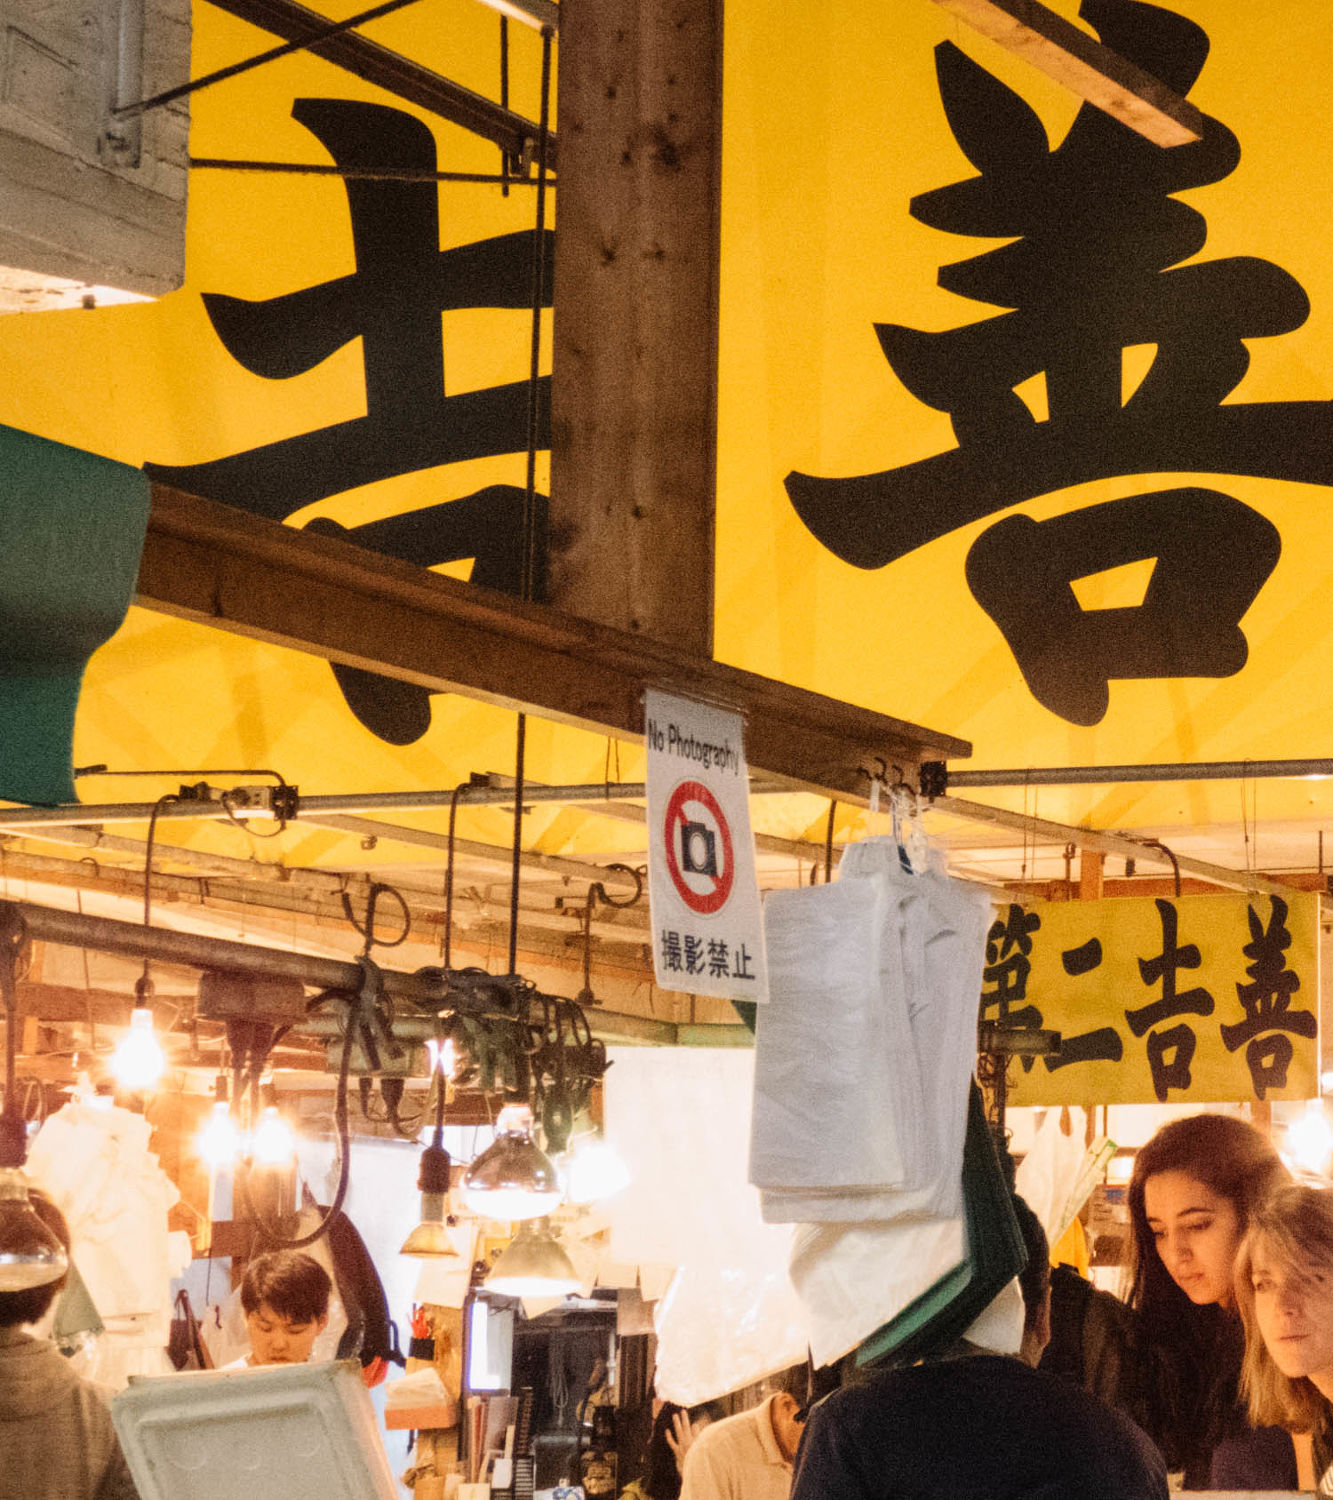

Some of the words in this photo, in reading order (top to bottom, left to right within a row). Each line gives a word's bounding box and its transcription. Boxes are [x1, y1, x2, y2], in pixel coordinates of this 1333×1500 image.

[648, 718, 665, 752] No
[668, 723, 740, 776] Photography
[661, 929, 756, 981] 撮影禁止
[978, 894, 1318, 1102] 第二吉善
